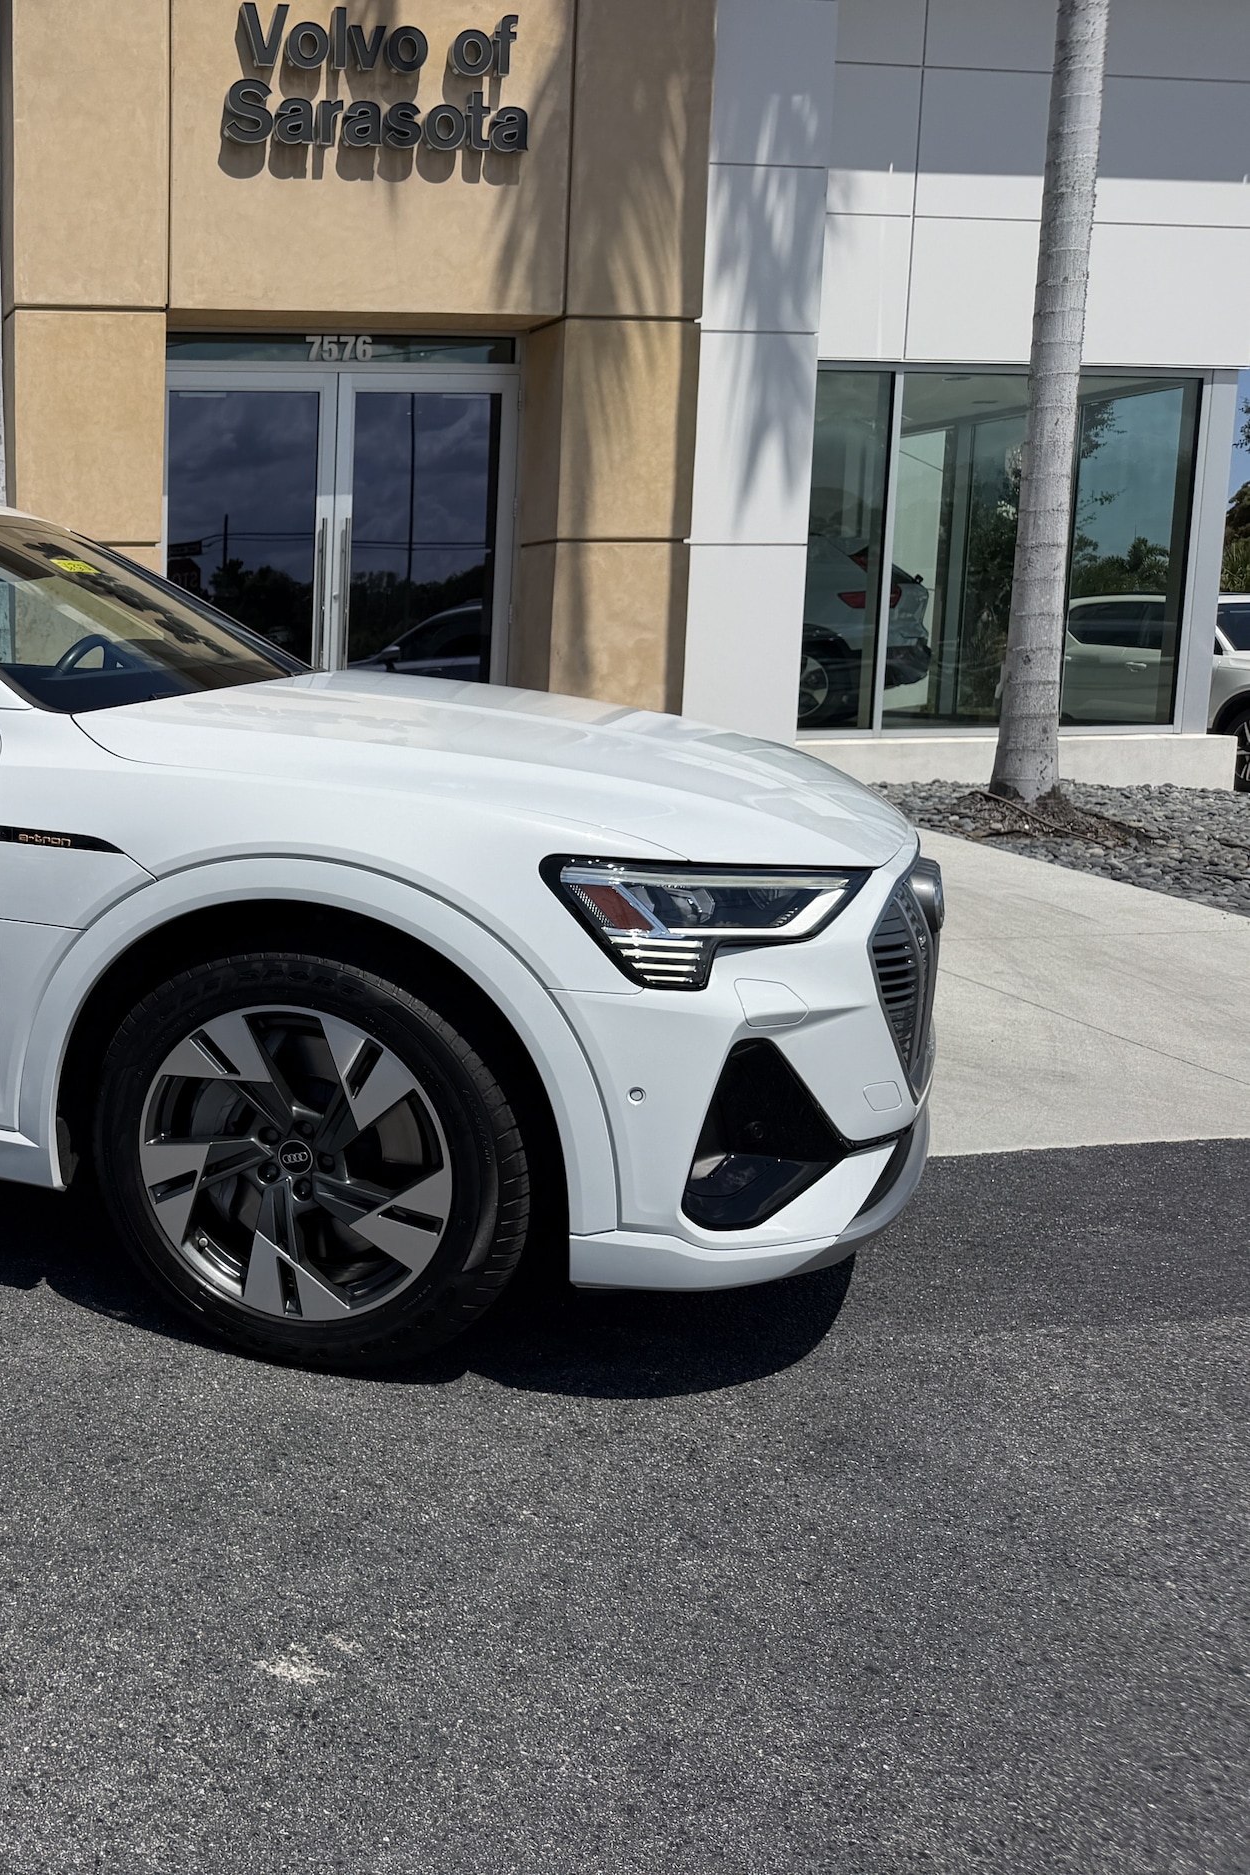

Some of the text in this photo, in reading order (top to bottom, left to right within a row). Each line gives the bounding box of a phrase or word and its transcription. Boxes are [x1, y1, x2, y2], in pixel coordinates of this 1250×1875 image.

[238, 2, 519, 77] Volvo of
[224, 78, 528, 152] Sarasota
[305, 335, 373, 361] 7576
